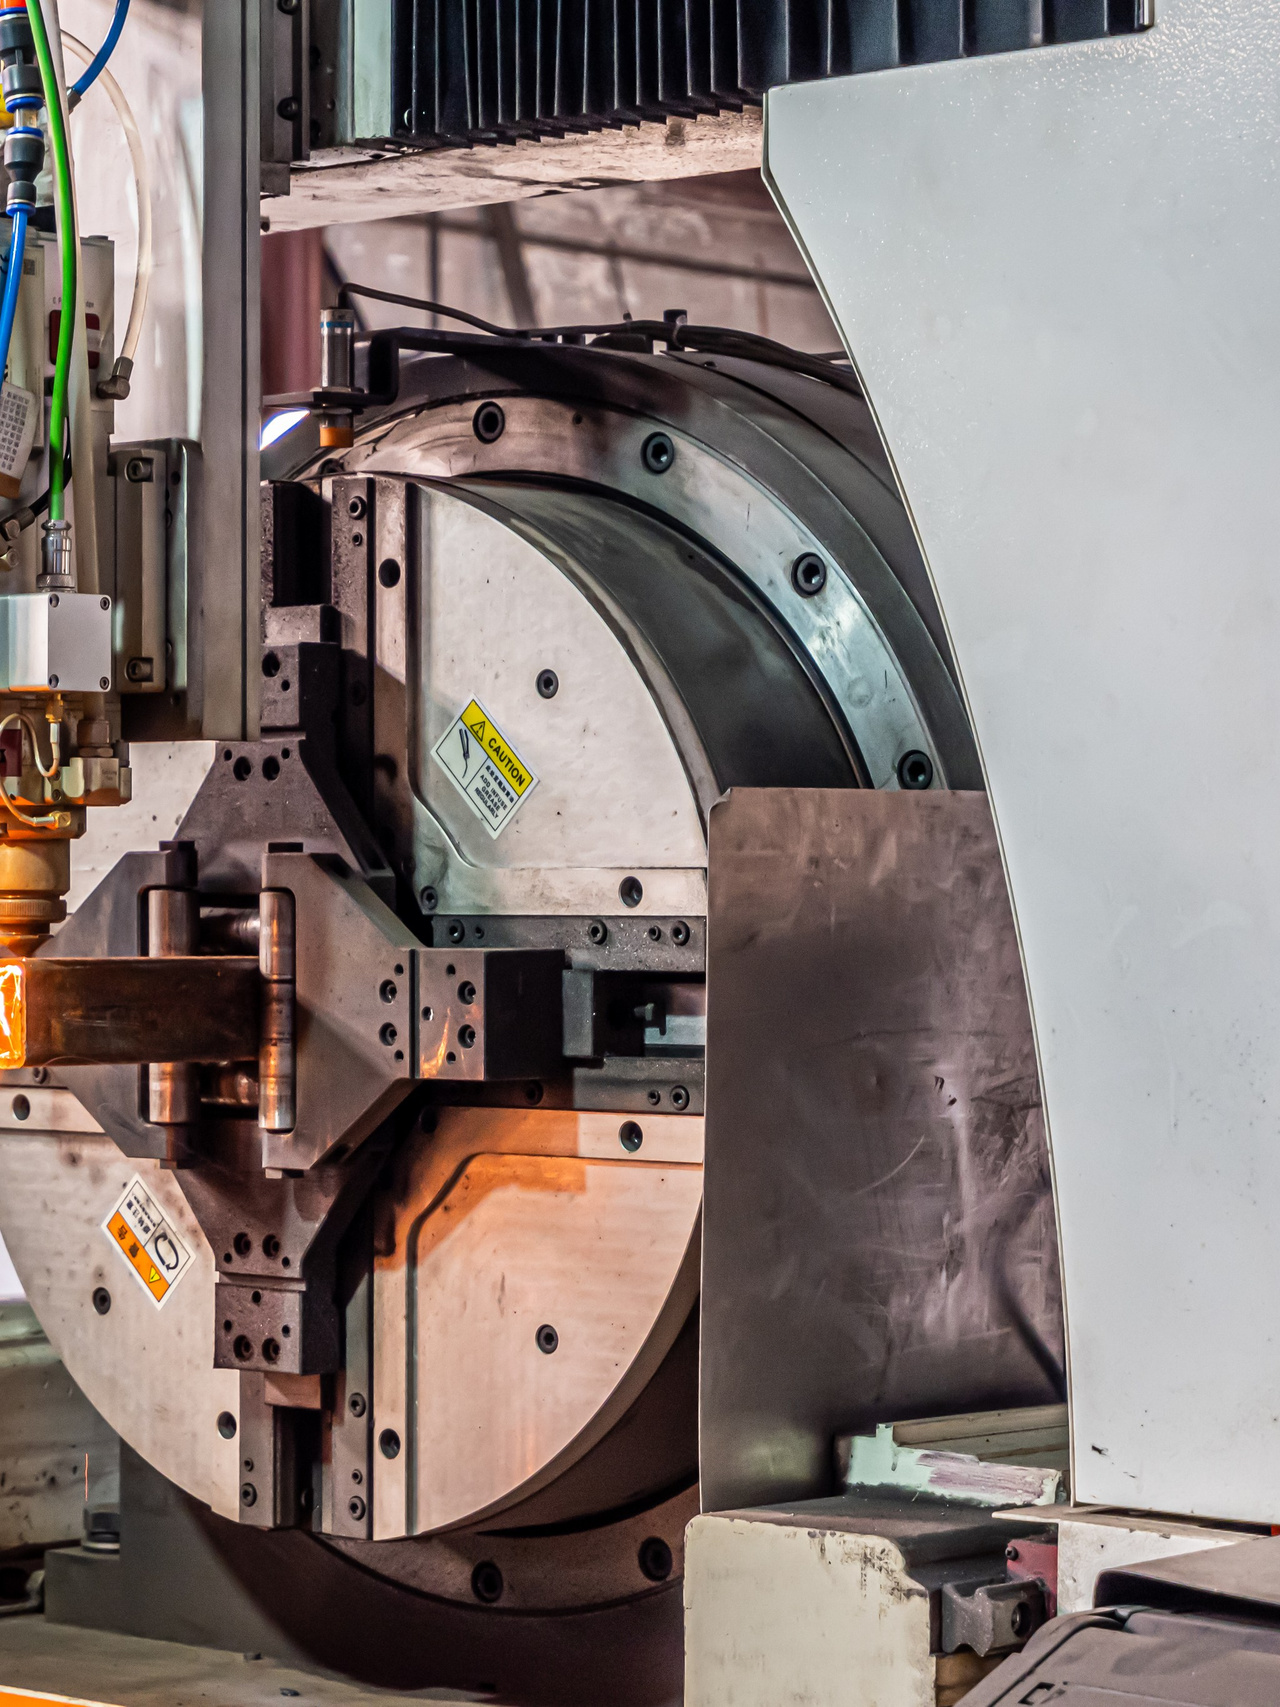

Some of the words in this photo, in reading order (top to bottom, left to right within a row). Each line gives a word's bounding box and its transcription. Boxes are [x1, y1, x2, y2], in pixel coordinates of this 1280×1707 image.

[488, 738, 526, 787] CAUTION
[474, 787, 499, 819] REGULARLY
[479, 774, 491, 788] ADD
[490, 787, 508, 811] INFUSE
[481, 786, 501, 811] GREASE
